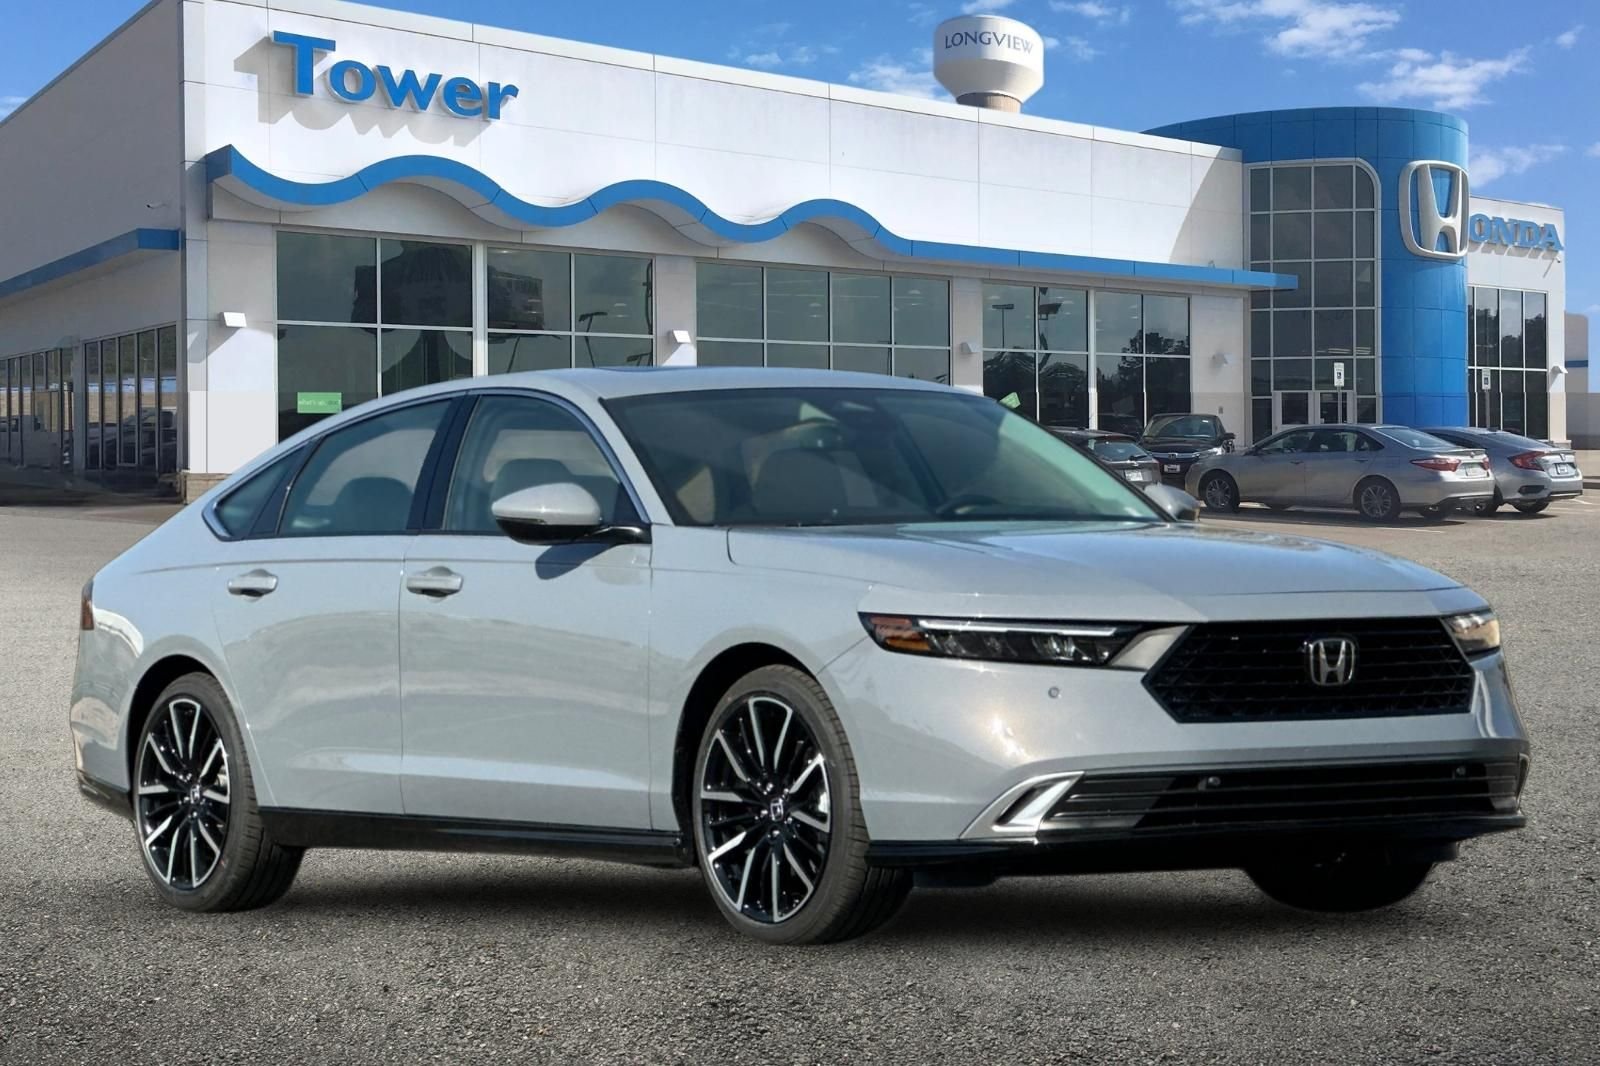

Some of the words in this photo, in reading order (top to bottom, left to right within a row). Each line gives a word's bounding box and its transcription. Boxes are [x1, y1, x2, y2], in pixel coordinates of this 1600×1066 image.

[945, 31, 1034, 55] LONGVIEW
[273, 30, 519, 120] Tower
[1469, 213, 1564, 250] ONDA
